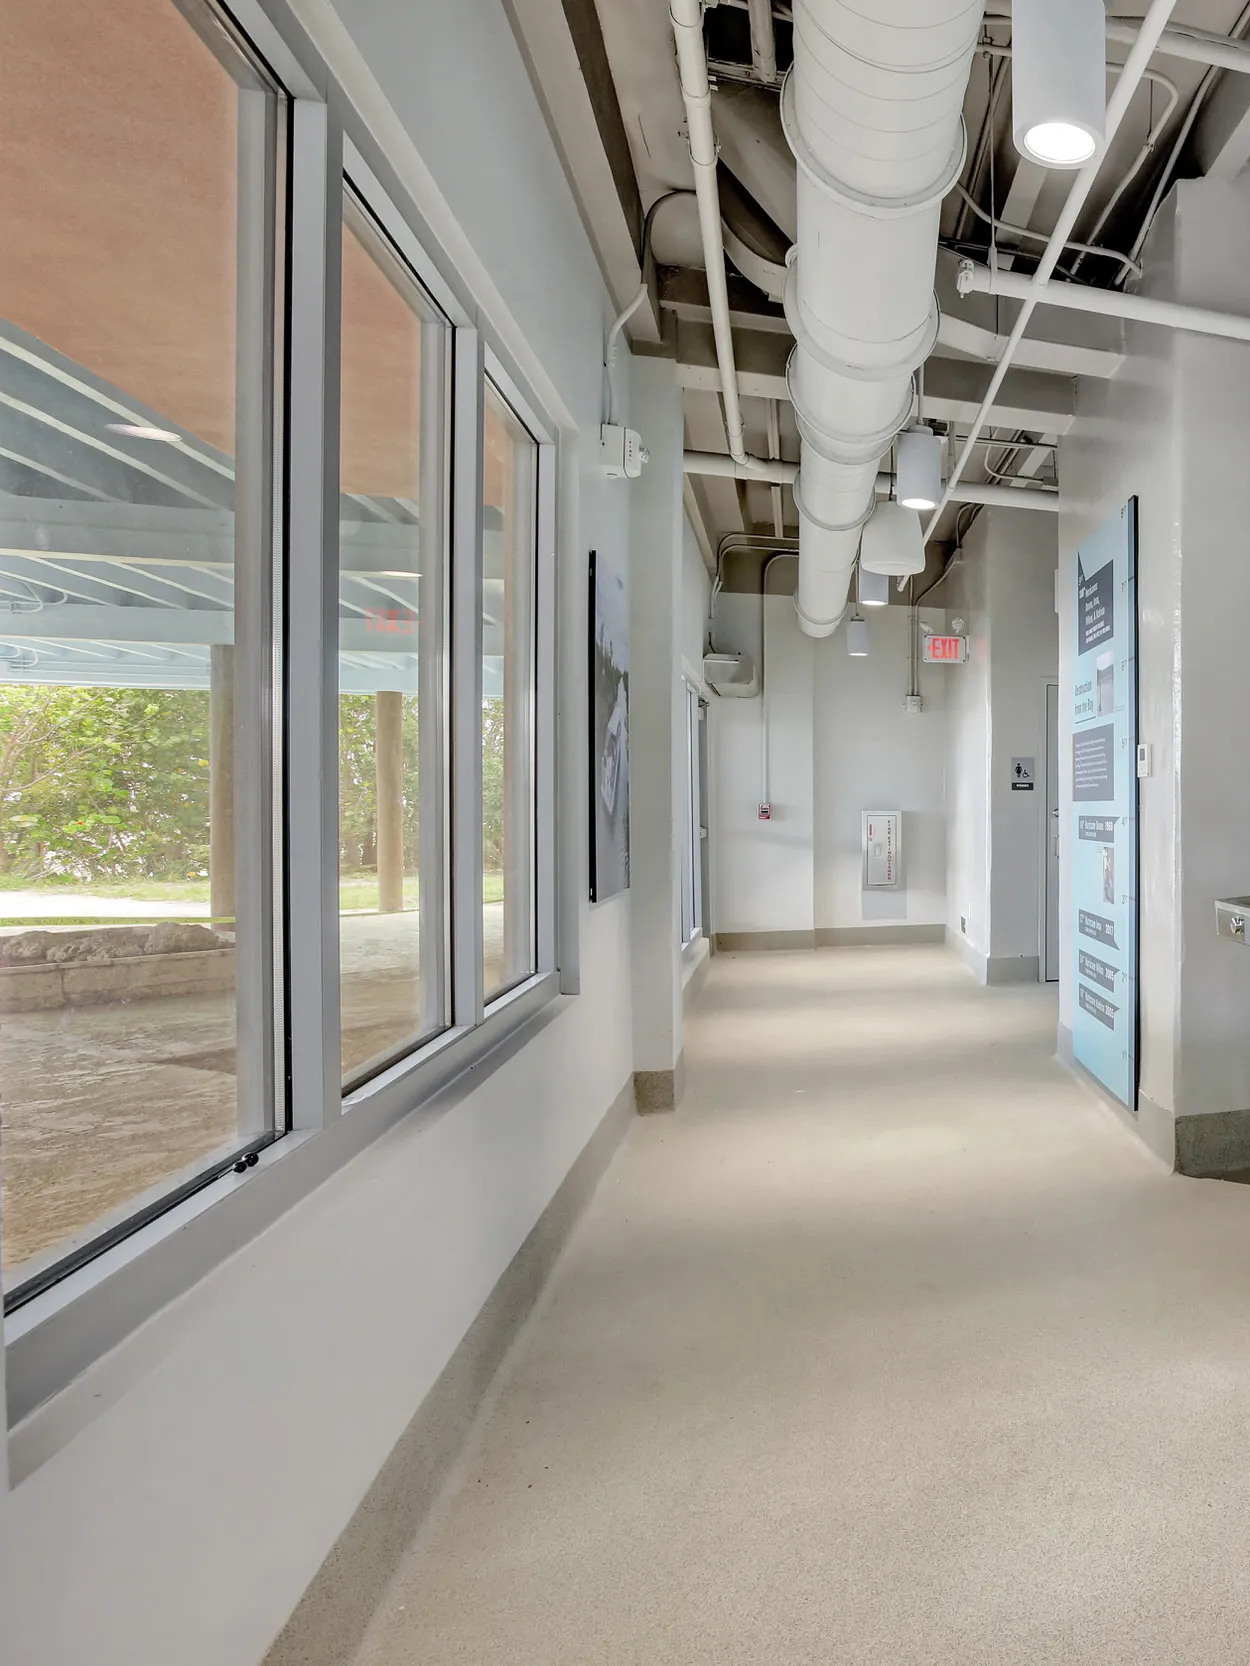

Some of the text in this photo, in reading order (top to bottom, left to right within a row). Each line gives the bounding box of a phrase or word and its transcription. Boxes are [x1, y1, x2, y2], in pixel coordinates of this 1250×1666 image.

[932, 637, 960, 659] EXIT
[1105, 923, 1113, 936] 2017
[1105, 968, 1114, 981] 2005
[1105, 1004, 1114, 1018] 2005
